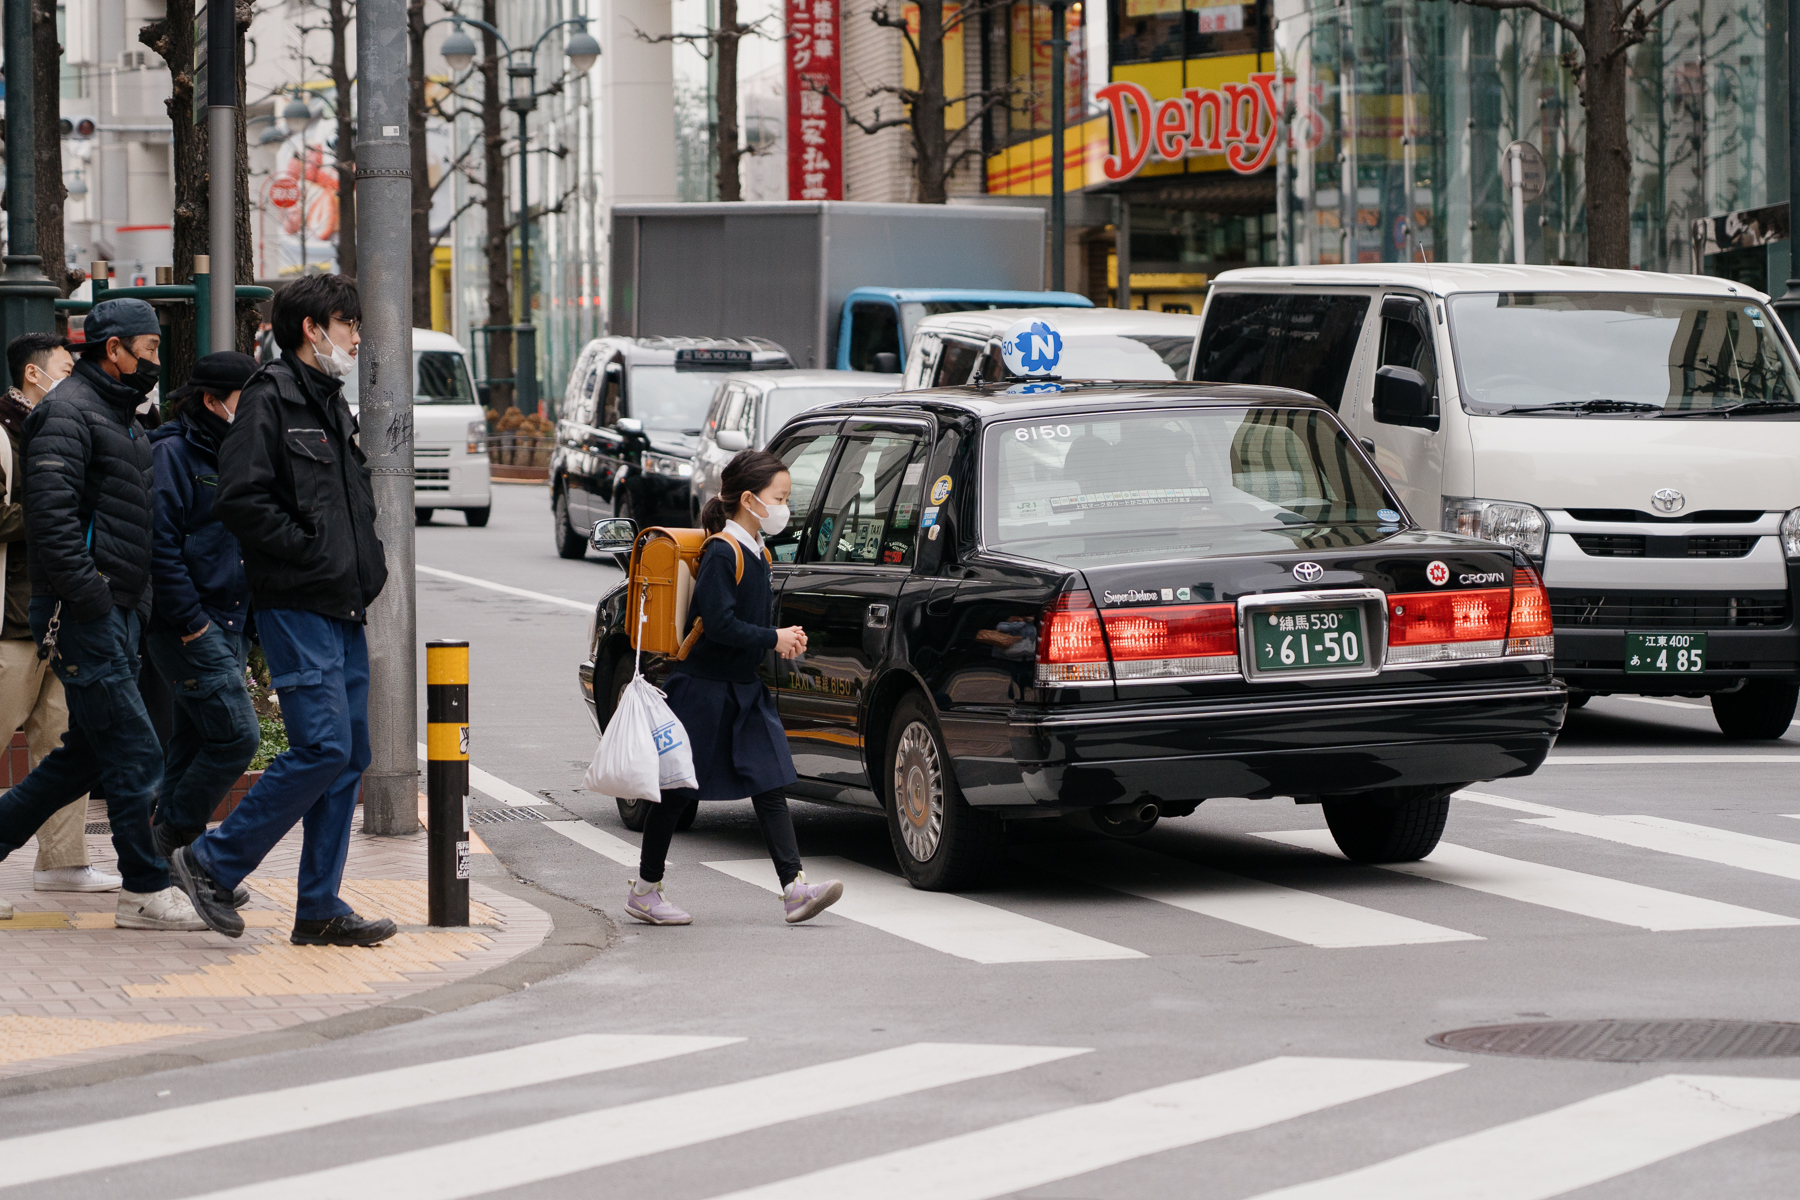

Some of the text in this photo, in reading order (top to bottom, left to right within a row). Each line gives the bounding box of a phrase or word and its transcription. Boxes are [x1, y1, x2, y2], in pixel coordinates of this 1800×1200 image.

[694, 351, 748, 360] TOKYO TAXI
[1031, 334, 1055, 361] N
[1014, 424, 1072, 441] 6150
[870, 524, 883, 535] TAXI
[1434, 568, 1442, 578] N
[1459, 572, 1505, 584] CROWN
[1103, 590, 1158, 605] Super Deluxe
[1279, 613, 1338, 632] 練馬 530
[1264, 631, 1359, 665] う 61-50
[1645, 635, 1690, 648] 江東 400
[1630, 655, 1641, 667] あ
[1677, 649, 1702, 672] 85
[789, 671, 810, 690] TAXI
[831, 677, 851, 695] 6150
